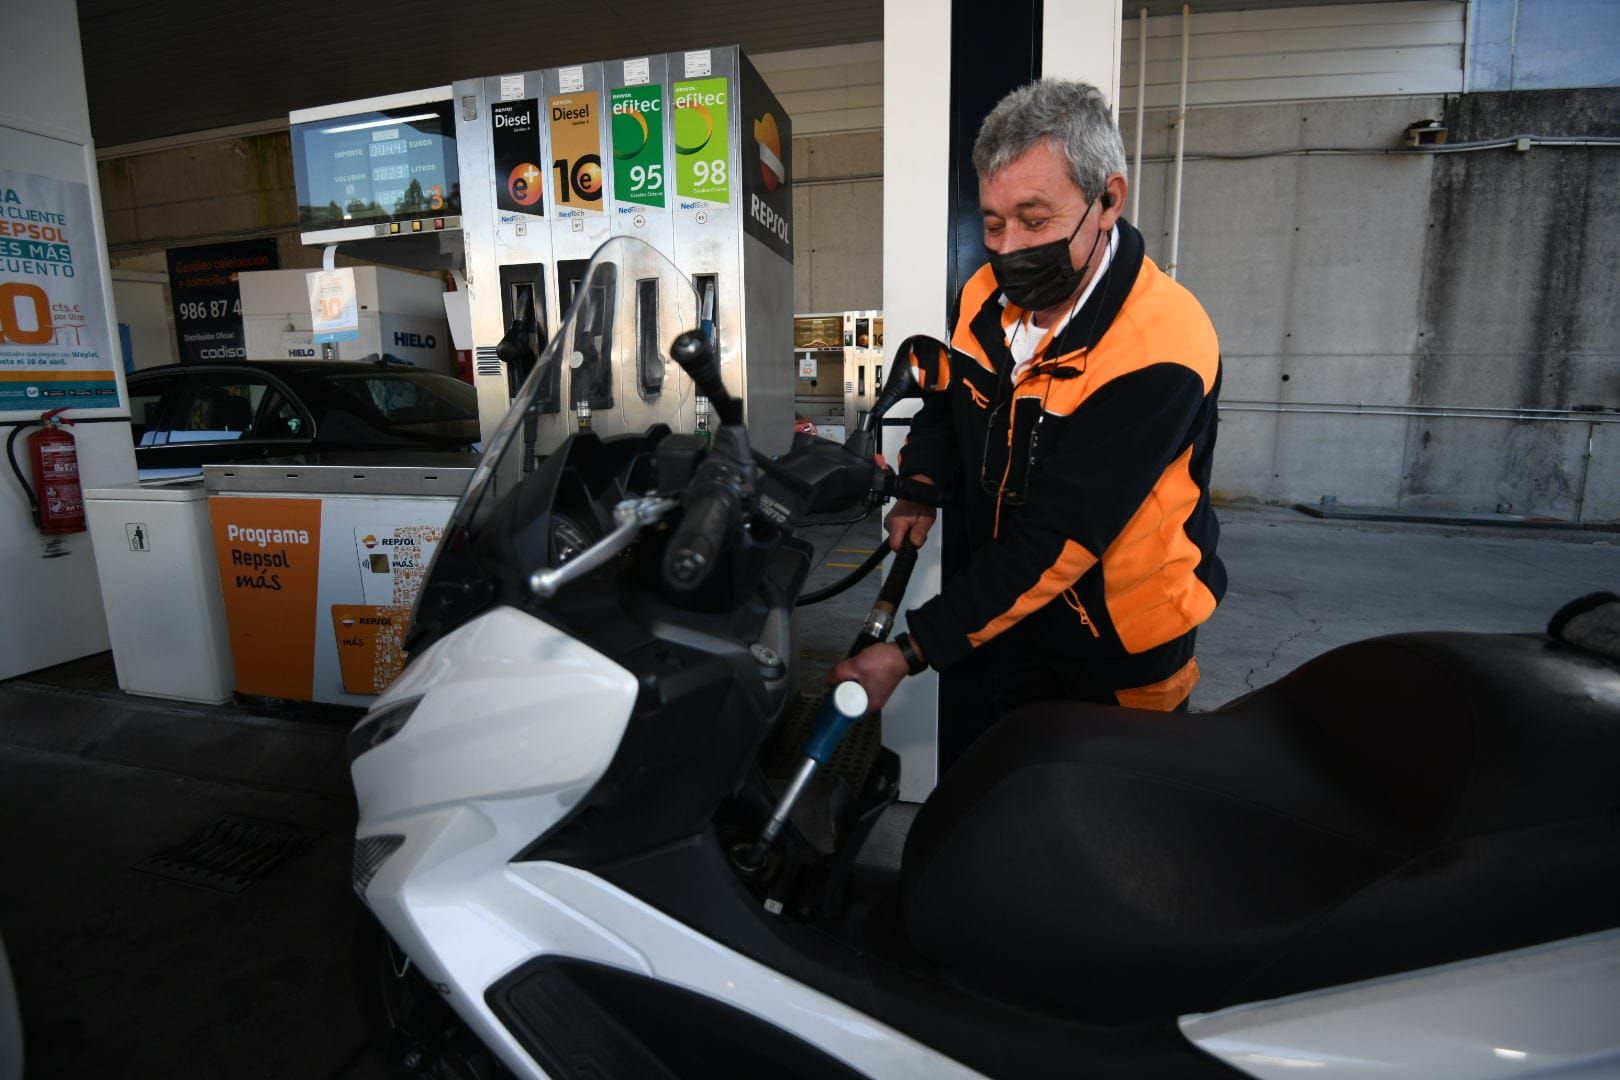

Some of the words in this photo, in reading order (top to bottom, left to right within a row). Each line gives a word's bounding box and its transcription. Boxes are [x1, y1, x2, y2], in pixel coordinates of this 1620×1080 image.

[612, 99, 661, 115] efitec
[676, 91, 726, 109] efitec
[495, 111, 531, 128] Diesel
[552, 103, 589, 121] Diesel
[409, 139, 433, 149] EUROS
[411, 164, 437, 174] LITROS
[630, 164, 663, 191] 95
[693, 159, 727, 187] 98
[431, 185, 444, 210] 3
[7, 207, 66, 226] CLIENTE
[751, 193, 789, 246] REPSOL
[29, 242, 70, 262] MÁS
[180, 302, 207, 320] 986
[210, 300, 228, 319] 87
[394, 331, 436, 349] HIELO
[288, 349, 315, 357] HIELO
[227, 524, 311, 548] Programa
[381, 538, 415, 547] REPSOL
[231, 548, 290, 574] Repsol
[392, 557, 414, 568] más
[236, 569, 282, 591] más
[358, 617, 393, 626] REPSOL
[342, 635, 364, 647] más
